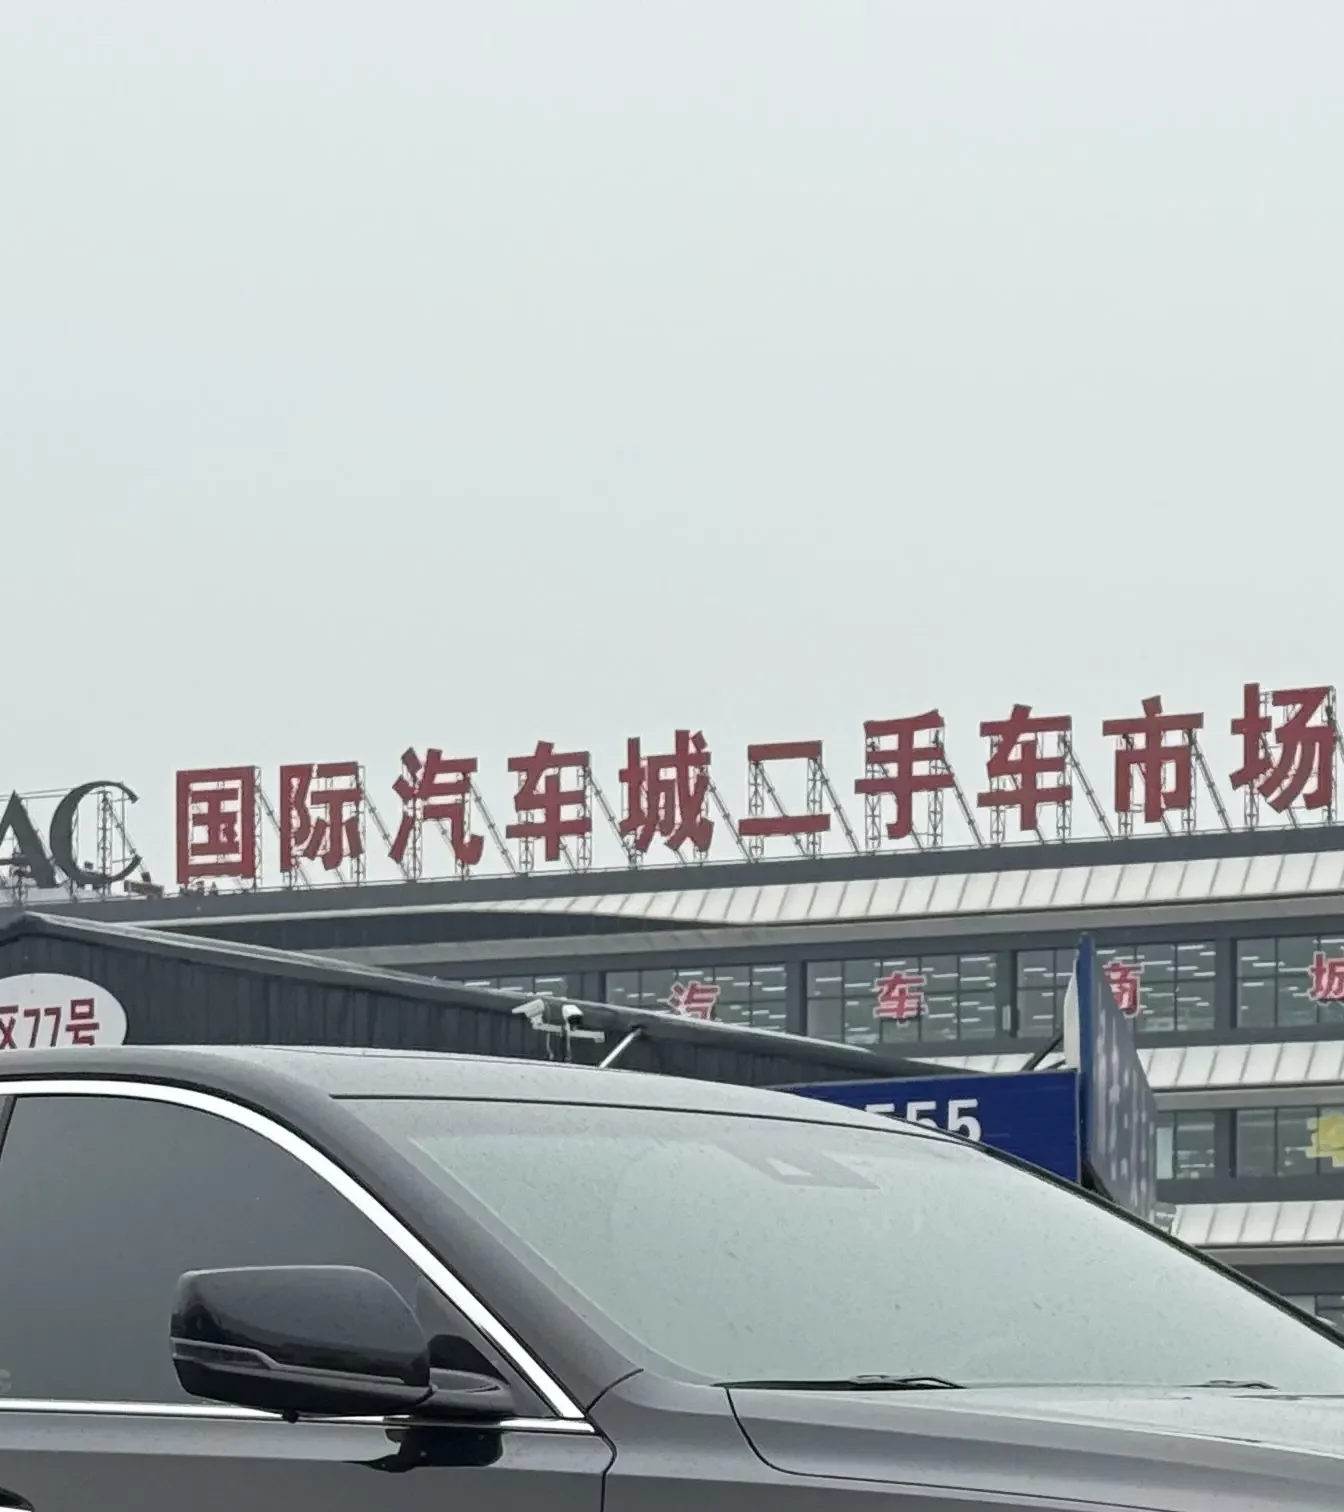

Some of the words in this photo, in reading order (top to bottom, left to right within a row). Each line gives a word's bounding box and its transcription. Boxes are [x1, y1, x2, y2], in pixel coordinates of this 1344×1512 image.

[176, 682, 1338, 884] 国际汽车城二手车市场
[864, 1097, 983, 1143] 55
